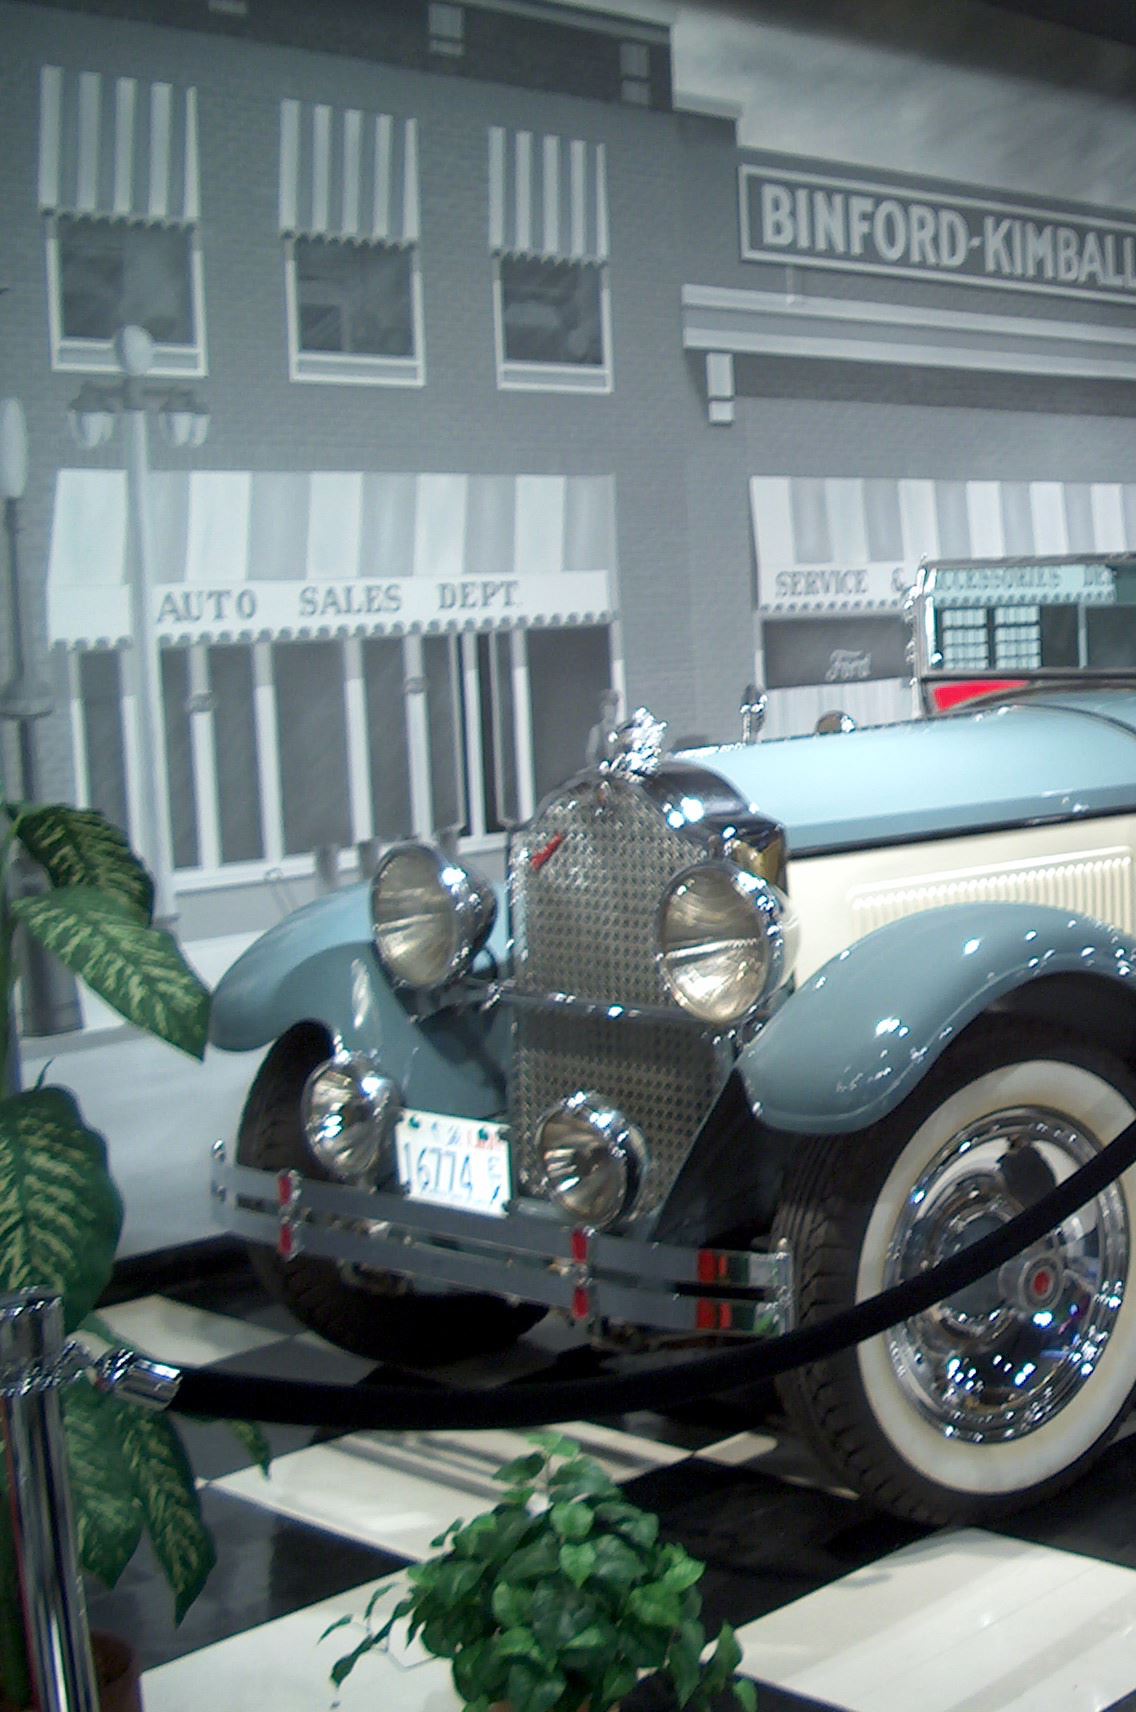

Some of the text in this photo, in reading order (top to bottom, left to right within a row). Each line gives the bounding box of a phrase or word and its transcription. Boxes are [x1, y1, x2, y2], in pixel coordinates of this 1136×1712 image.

[775, 569, 869, 598] SERVICE
[156, 588, 257, 624] AUTO
[298, 584, 402, 617] SALES
